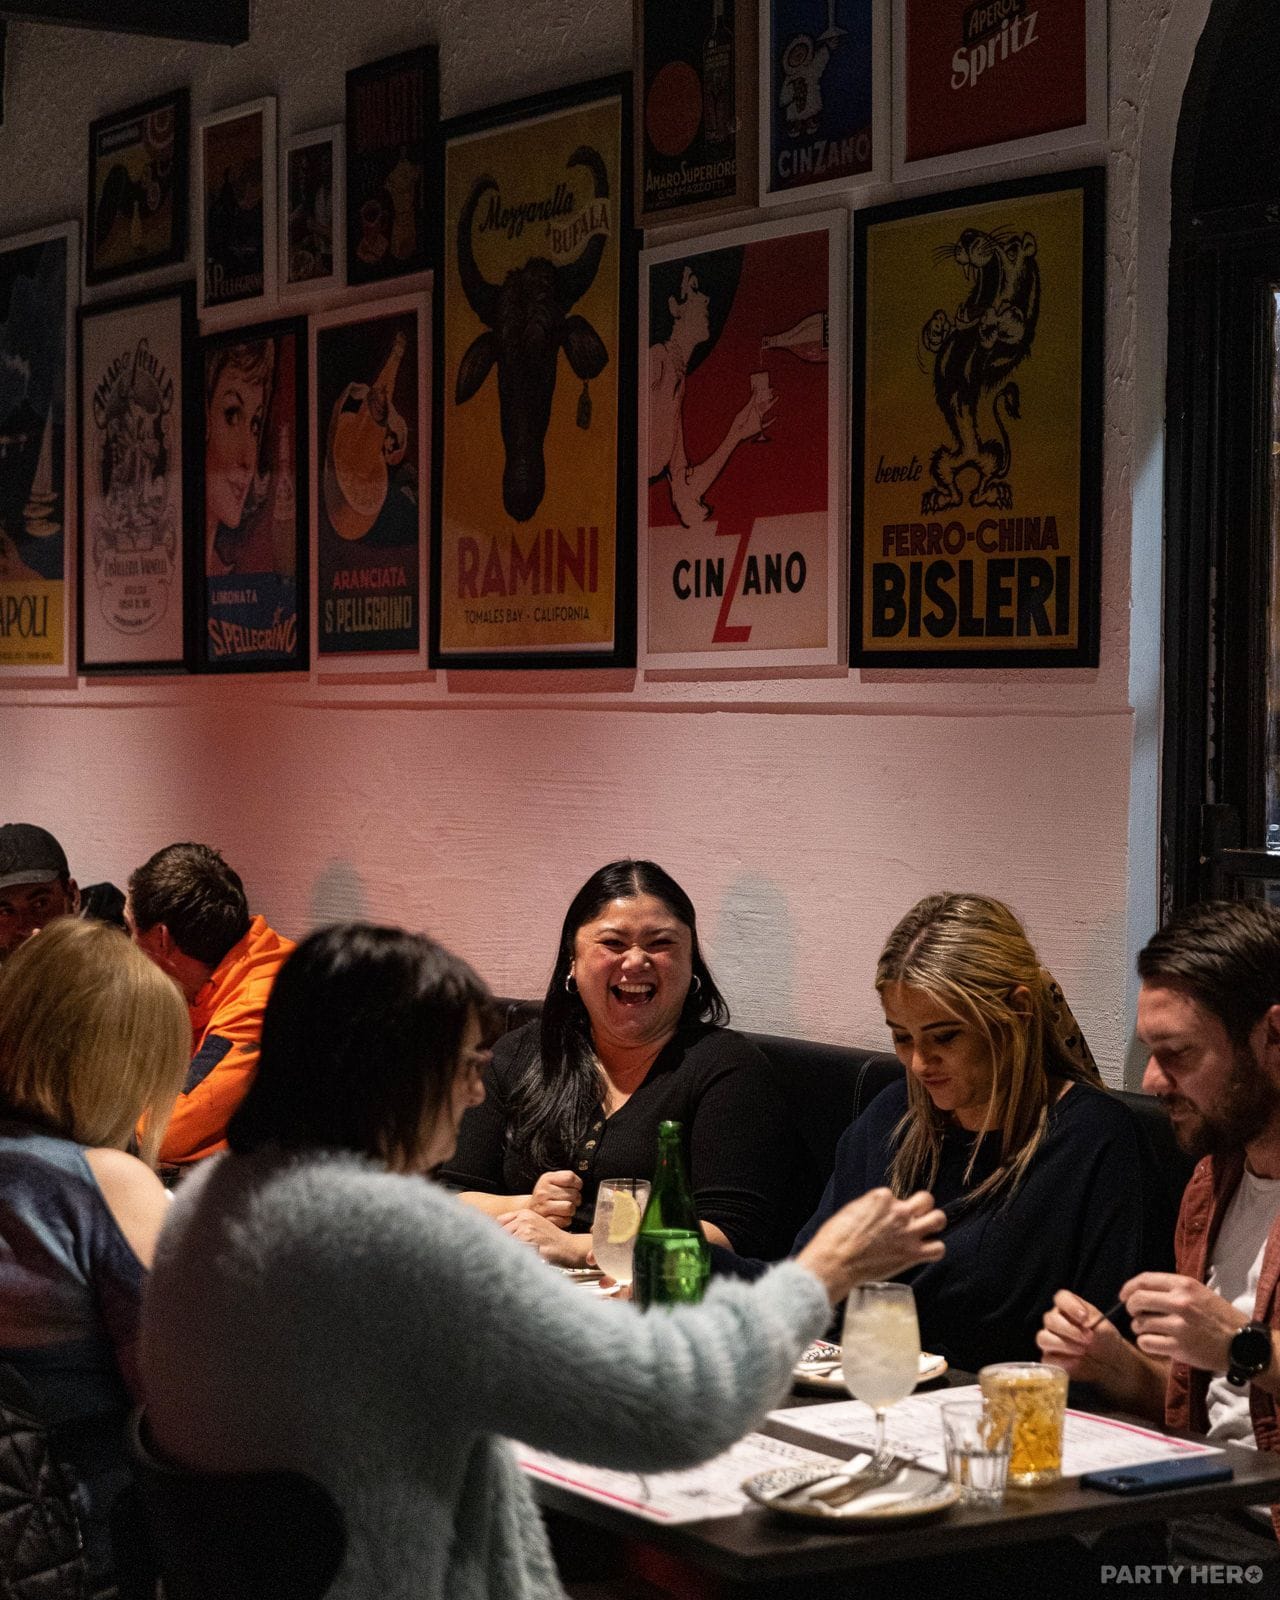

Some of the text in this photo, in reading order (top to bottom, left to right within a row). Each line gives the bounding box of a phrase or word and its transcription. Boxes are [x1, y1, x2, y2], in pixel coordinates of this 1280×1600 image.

[951, 10, 1039, 90] Spritz
[777, 133, 871, 179] CINZANO
[479, 183, 574, 240] Mozzarella
[552, 204, 610, 254] BUFALA
[875, 455, 923, 483] bevete
[882, 516, 1060, 557] FERRO-CHINA
[332, 566, 408, 591] ARANCIATA
[457, 526, 599, 599] RAMINI
[336, 595, 412, 634] PELLEGRINO
[464, 605, 590, 624] TOMALES BAY CALIFORNIA
[872, 556, 1071, 638] BISLERI
